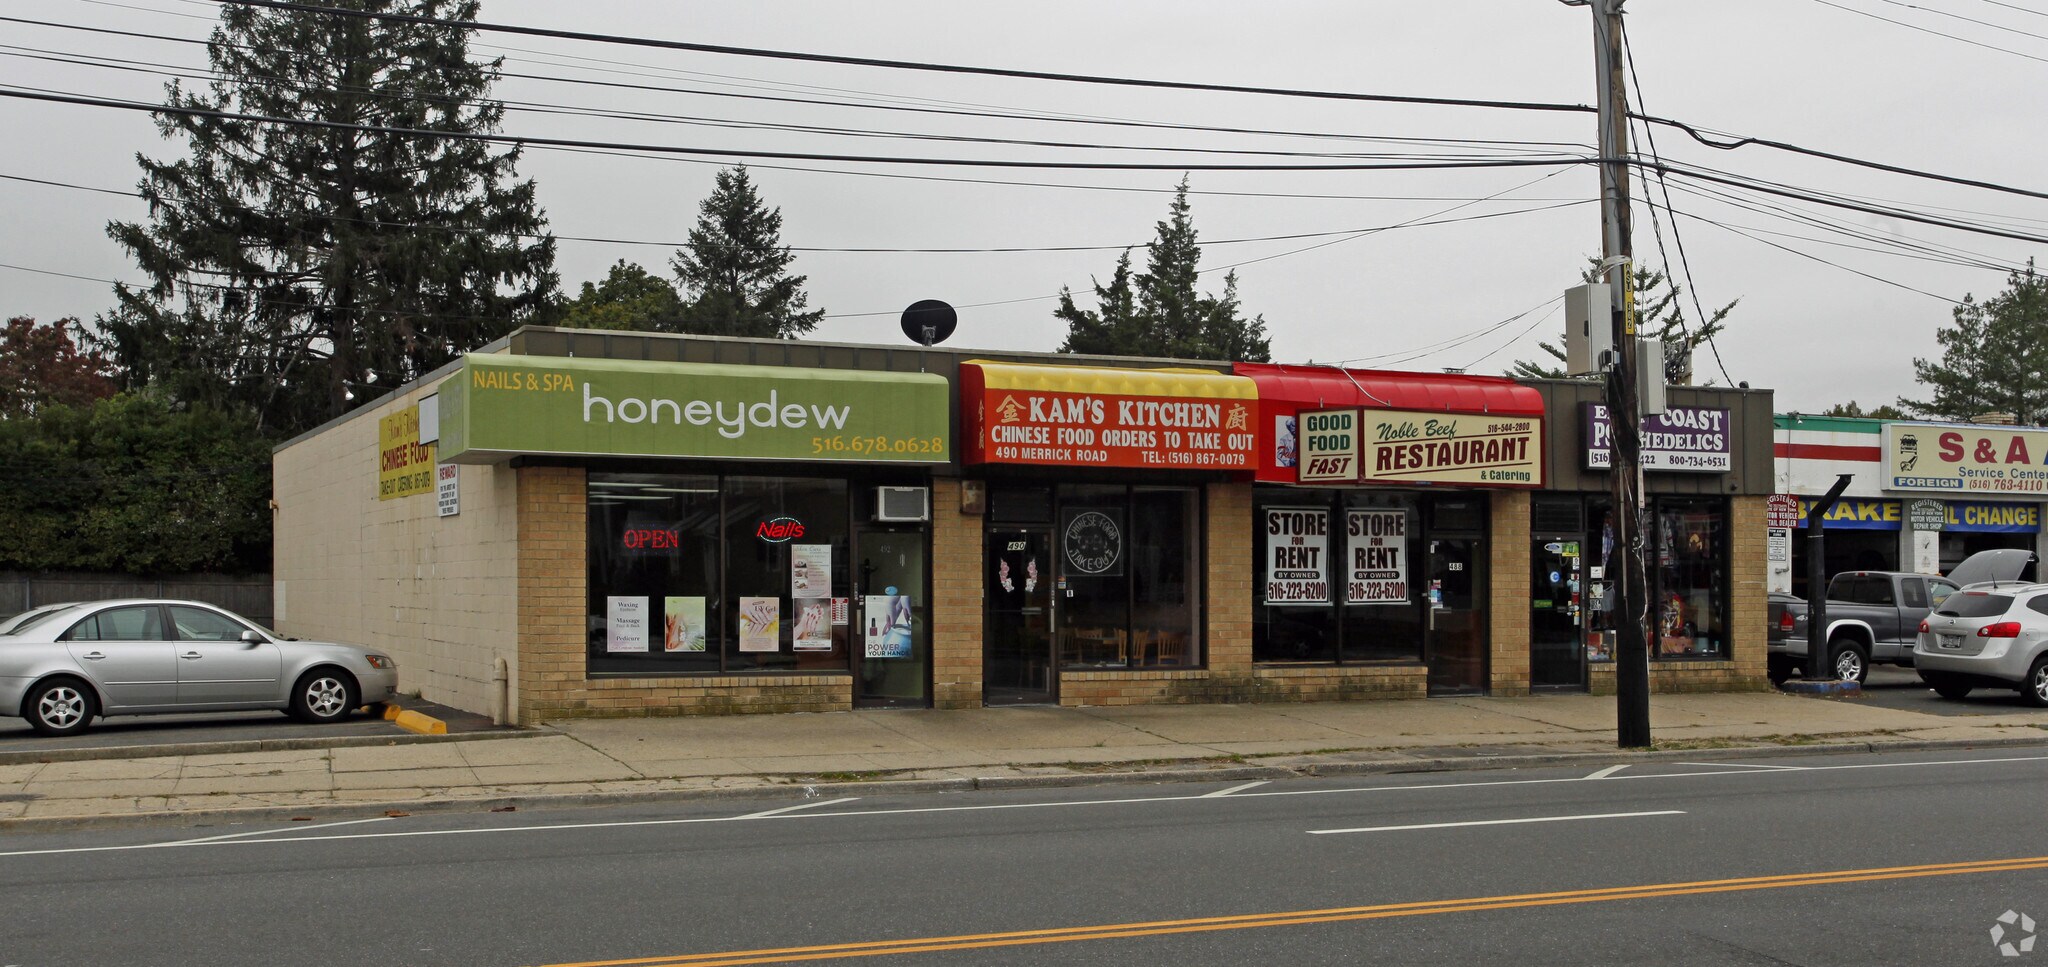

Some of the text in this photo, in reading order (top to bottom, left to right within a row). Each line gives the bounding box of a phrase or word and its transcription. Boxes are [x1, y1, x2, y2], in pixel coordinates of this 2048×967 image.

[474, 371, 574, 392] NAILS & SPA
[583, 382, 851, 438] honeydew
[996, 395, 1027, 423] 金
[1029, 397, 1221, 428] KAM'S KITCHEN
[1307, 414, 1351, 431] GOOD
[1377, 419, 1457, 441] Noble Beef
[1660, 409, 1722, 431] COAST
[812, 436, 943, 454] 516.678.0628
[991, 425, 1254, 451] CHINESE FOOD ORDERS TO TAKE OUT
[1308, 434, 1351, 451] FOOD
[1594, 422, 1723, 451] PHEDELICS
[382, 441, 429, 472] CHINESE FOOD
[996, 447, 1245, 465] 490 MERRICK ROAD TEL: (516) 867-0079
[1376, 437, 1530, 471] RESTAURANT
[1938, 432, 1964, 462] S
[1974, 438, 1997, 463] &
[2004, 436, 2031, 465] A
[1307, 457, 1351, 475] FAST
[1669, 455, 1727, 467] 800-734-6531
[440, 465, 456, 481] REWARD
[1481, 470, 1531, 482] & Catering
[1959, 467, 2004, 478] Service
[1898, 478, 1959, 488] FOREIGN
[1969, 479, 2043, 491] (516) 763-4110
[1911, 499, 1943, 511] REGISTERED
[1269, 512, 1326, 536] STORE
[1349, 514, 1404, 537] STORE
[1944, 506, 2038, 526] IL CHANGE
[757, 521, 805, 539] Nails
[1069, 515, 1117, 540] CHINESE FOOD
[624, 529, 678, 549] OPEN
[1008, 542, 1025, 550] 490
[1291, 537, 1304, 545] FOR
[1371, 537, 1383, 546] FOR
[1069, 549, 1093, 570] TAKE
[1275, 547, 1320, 569] RENT
[1355, 548, 1399, 569] RENT
[1268, 582, 1326, 600] 516-223-6200
[1349, 581, 1405, 600] 516-223-6200
